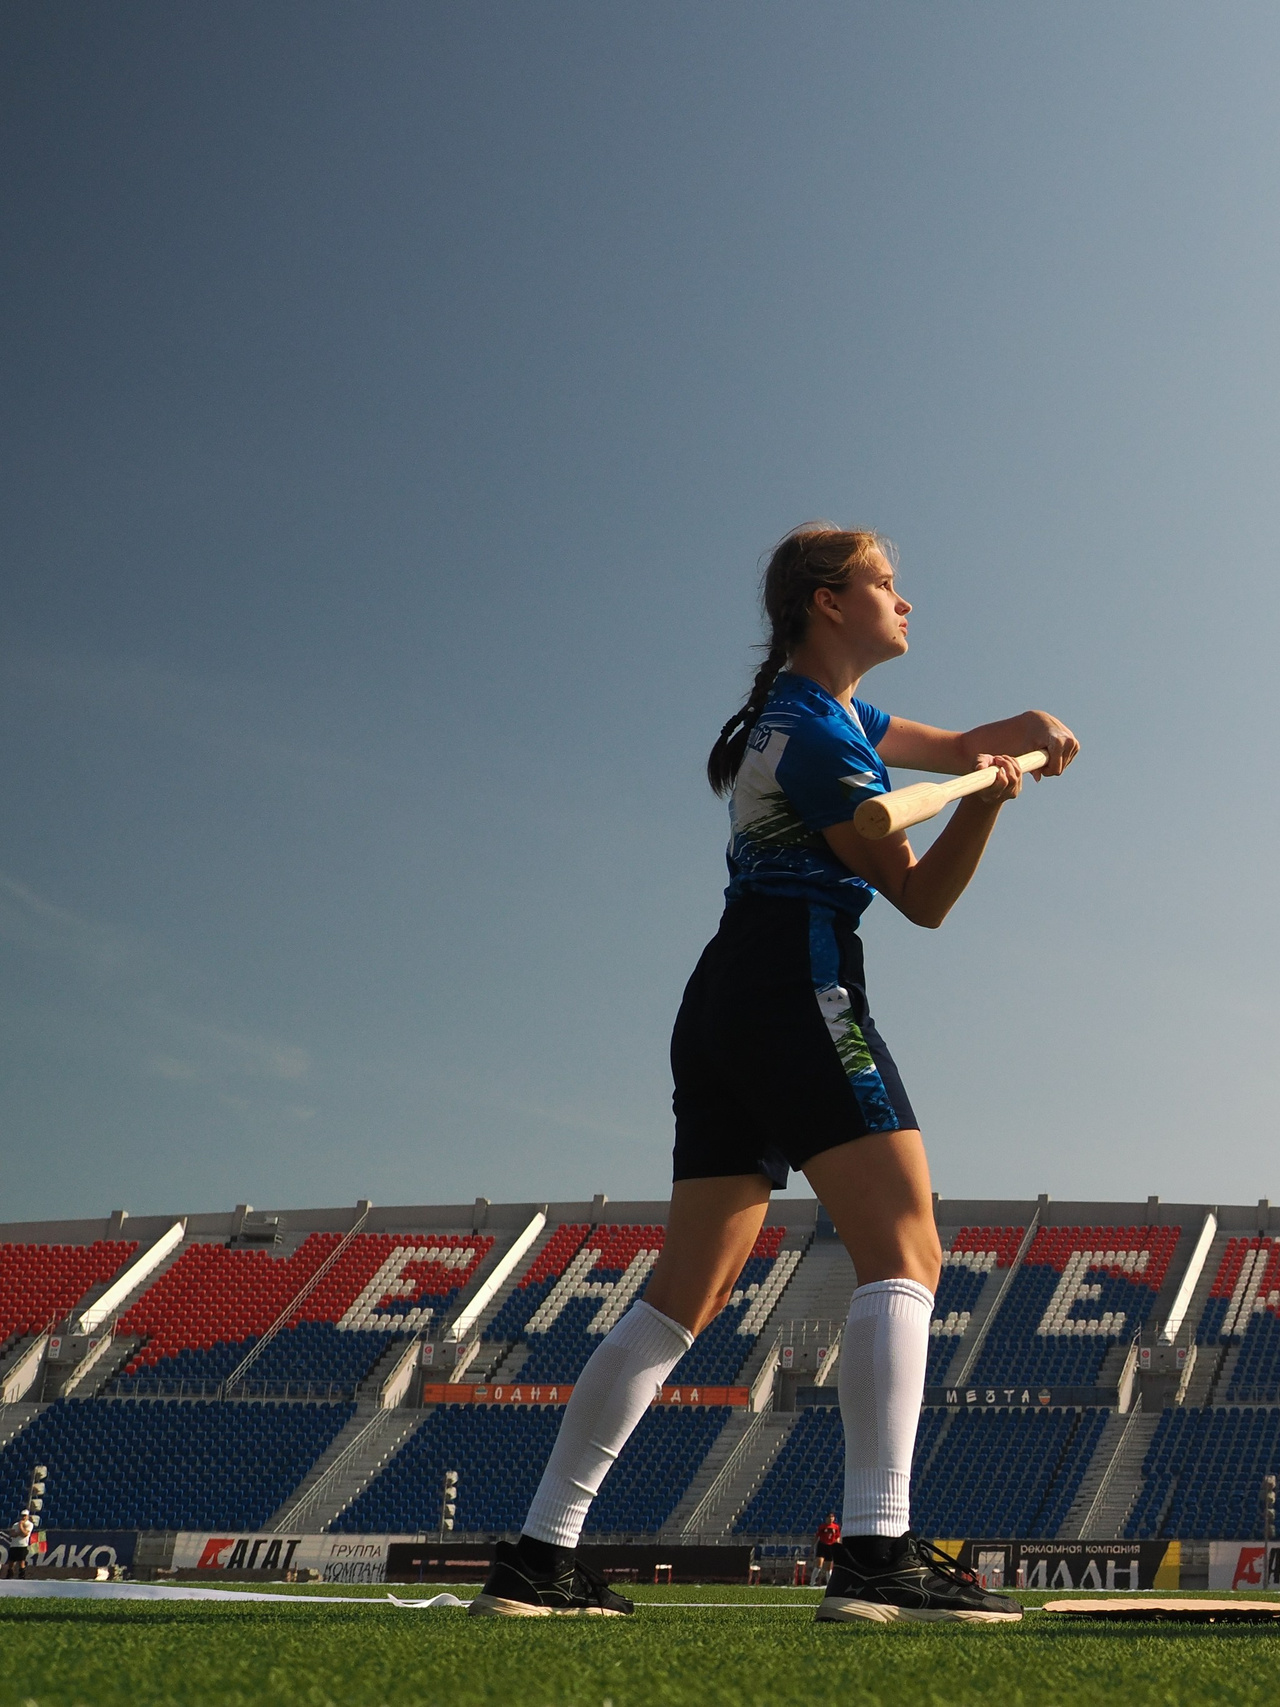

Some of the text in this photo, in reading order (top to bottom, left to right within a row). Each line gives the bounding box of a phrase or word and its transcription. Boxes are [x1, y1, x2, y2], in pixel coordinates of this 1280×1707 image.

[227, 1538, 302, 1569] АГАТ
[330, 1544, 381, 1557] ГРУППА
[1020, 1543, 1141, 1555] рекламная компания
